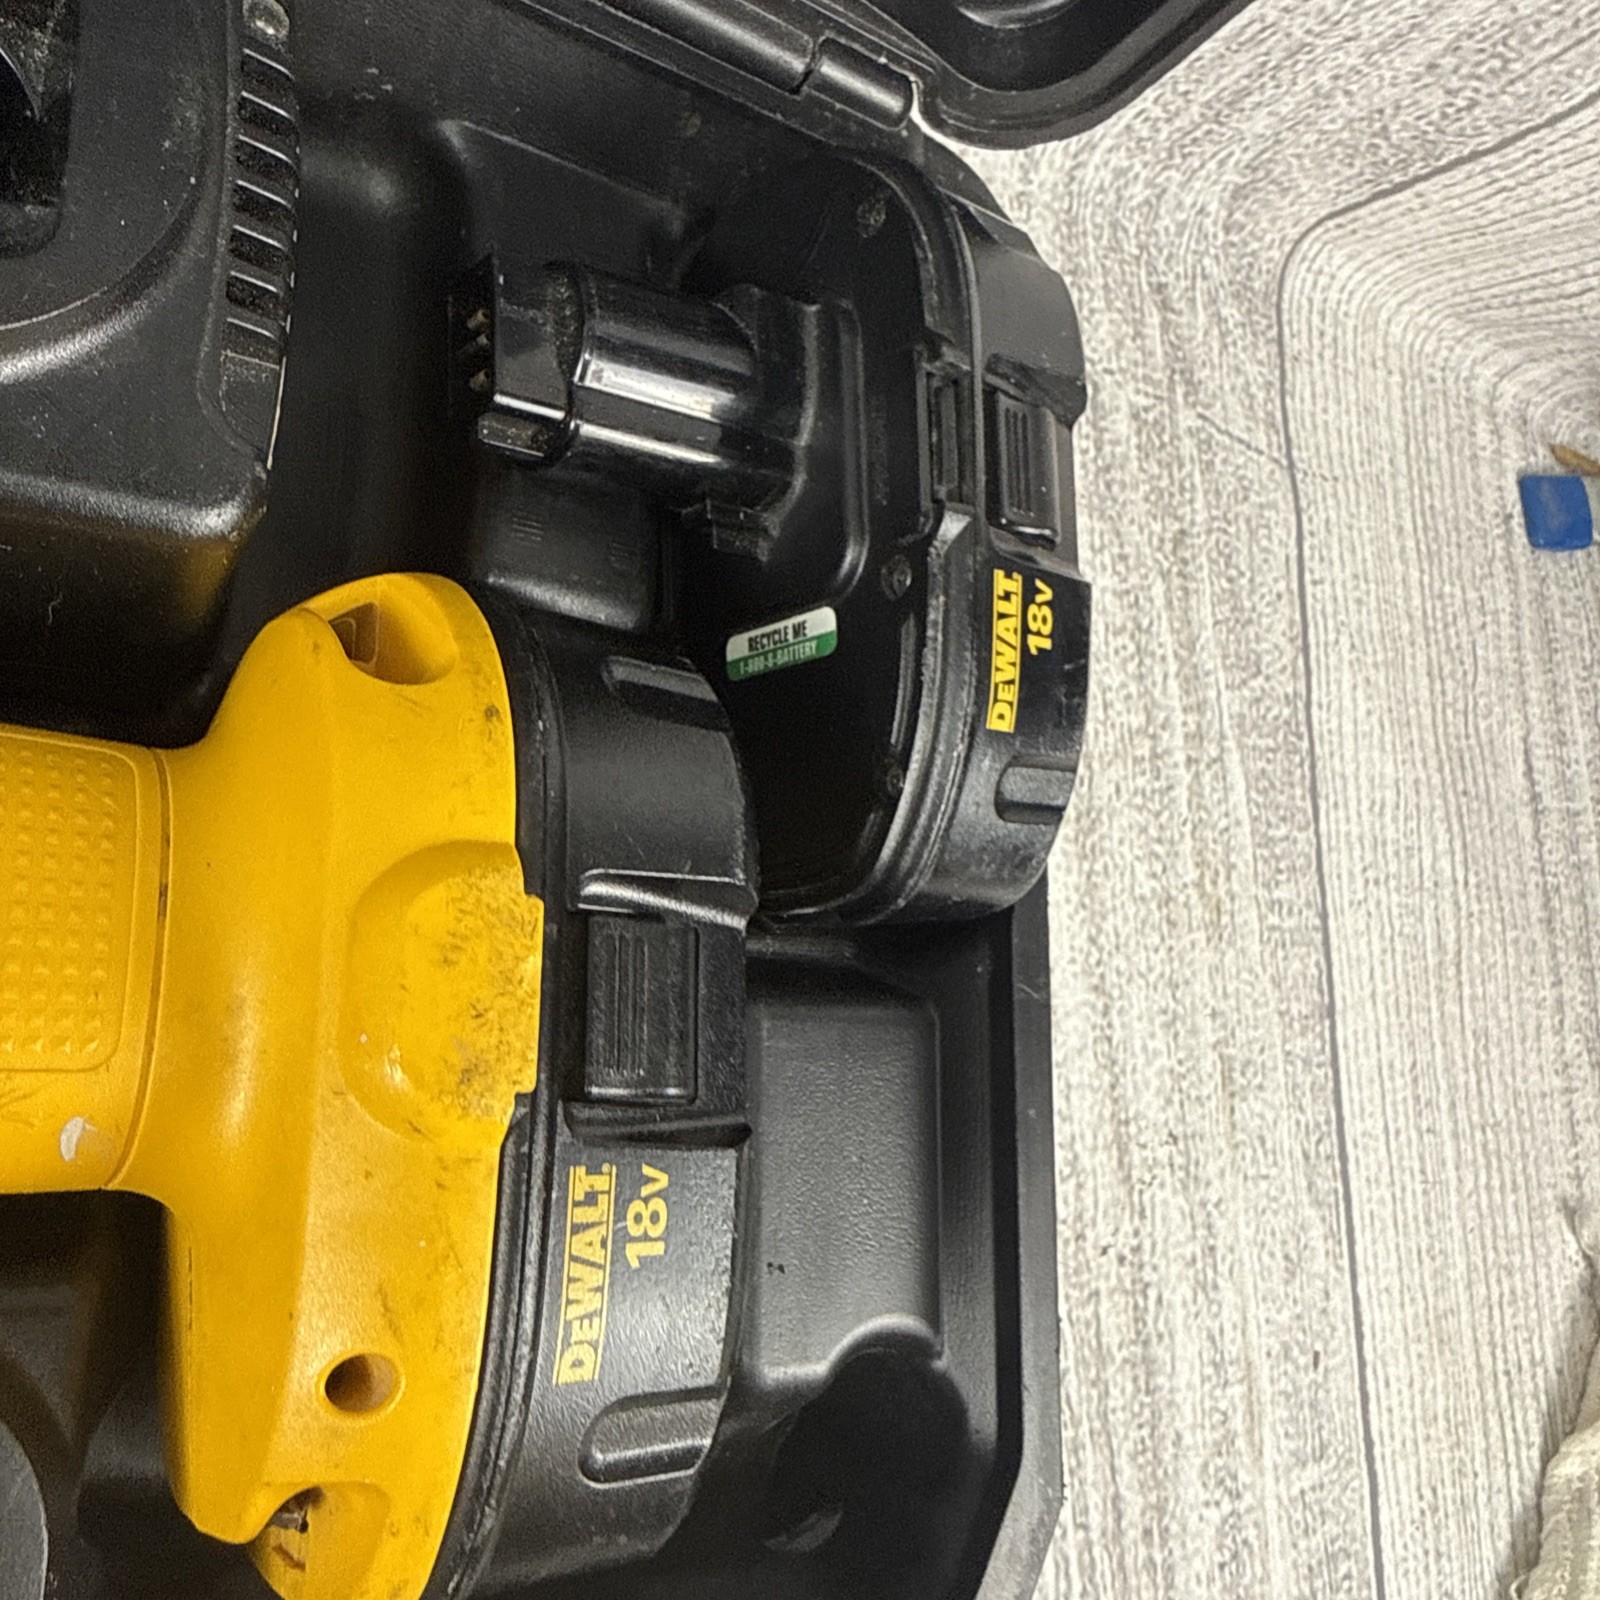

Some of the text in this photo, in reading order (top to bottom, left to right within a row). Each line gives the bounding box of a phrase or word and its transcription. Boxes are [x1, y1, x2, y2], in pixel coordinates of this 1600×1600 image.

[747, 619, 808, 653] RECYCLE ME
[986, 568, 1023, 733] DEWALT
[552, 1163, 616, 1385] DEWALT
